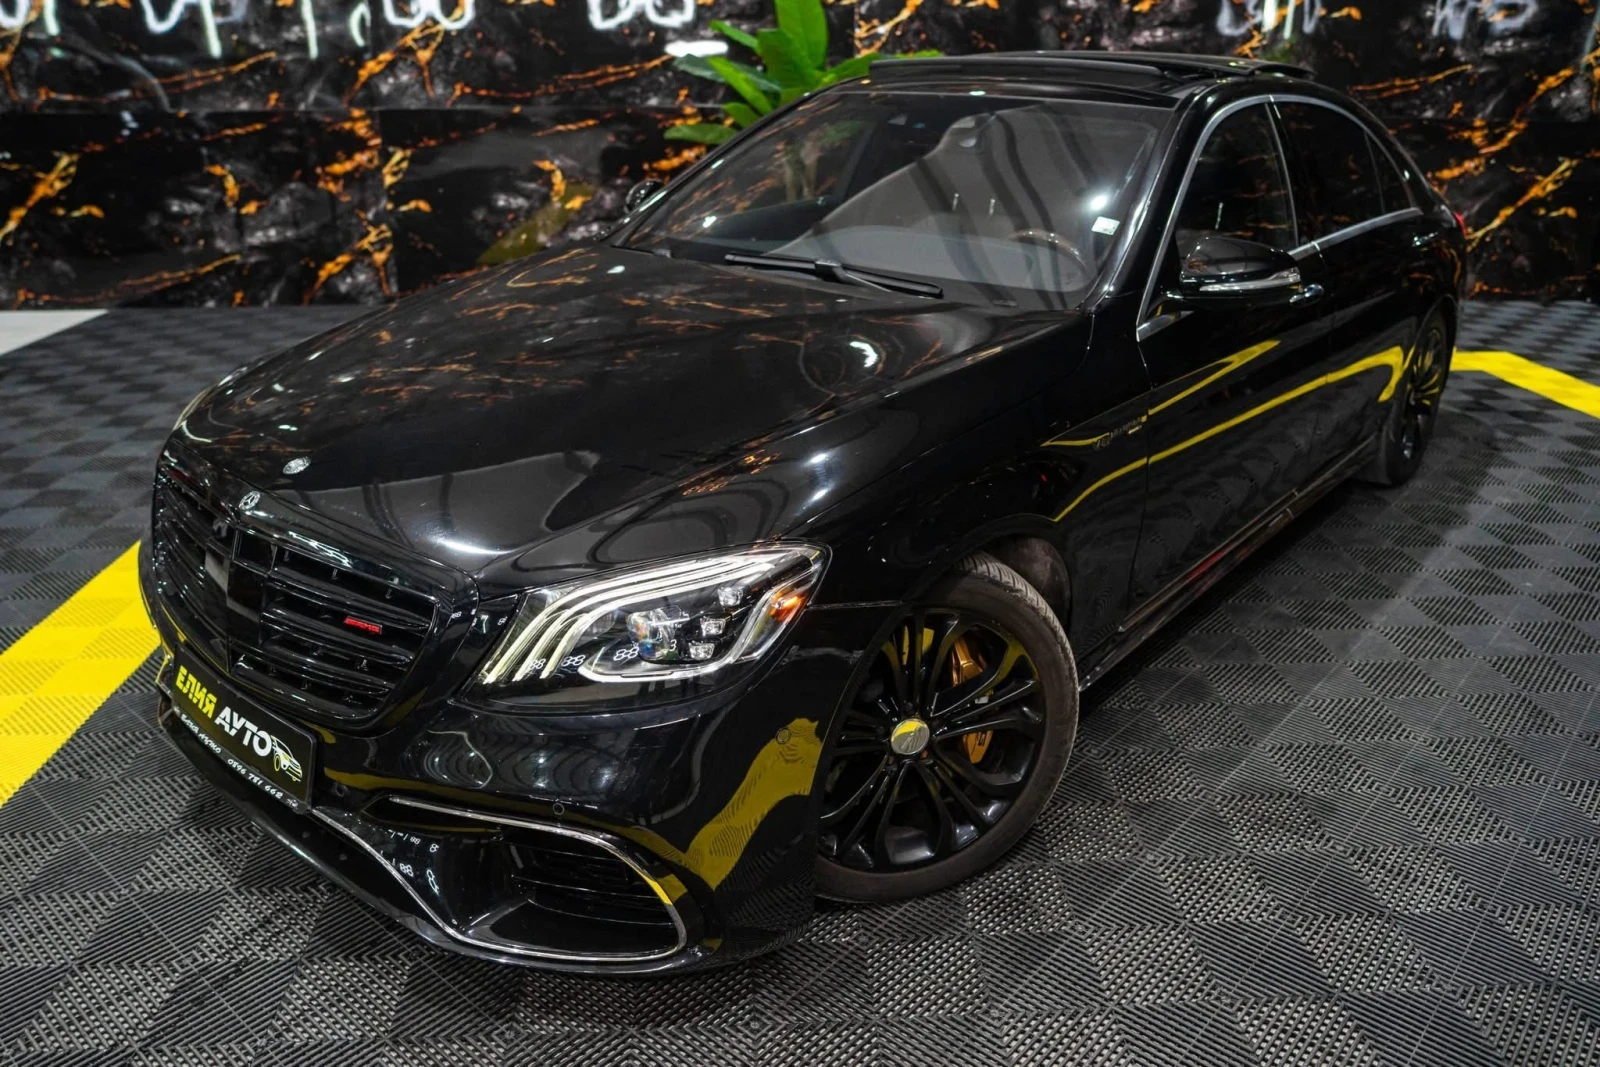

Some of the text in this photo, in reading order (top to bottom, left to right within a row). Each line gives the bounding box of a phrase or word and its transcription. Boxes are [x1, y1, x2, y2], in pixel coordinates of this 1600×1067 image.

[175, 664, 218, 719] ЕЛИЯ
[227, 758, 247, 775] 0896
[248, 772, 264, 786] 781
[264, 785, 284, 799] 662
